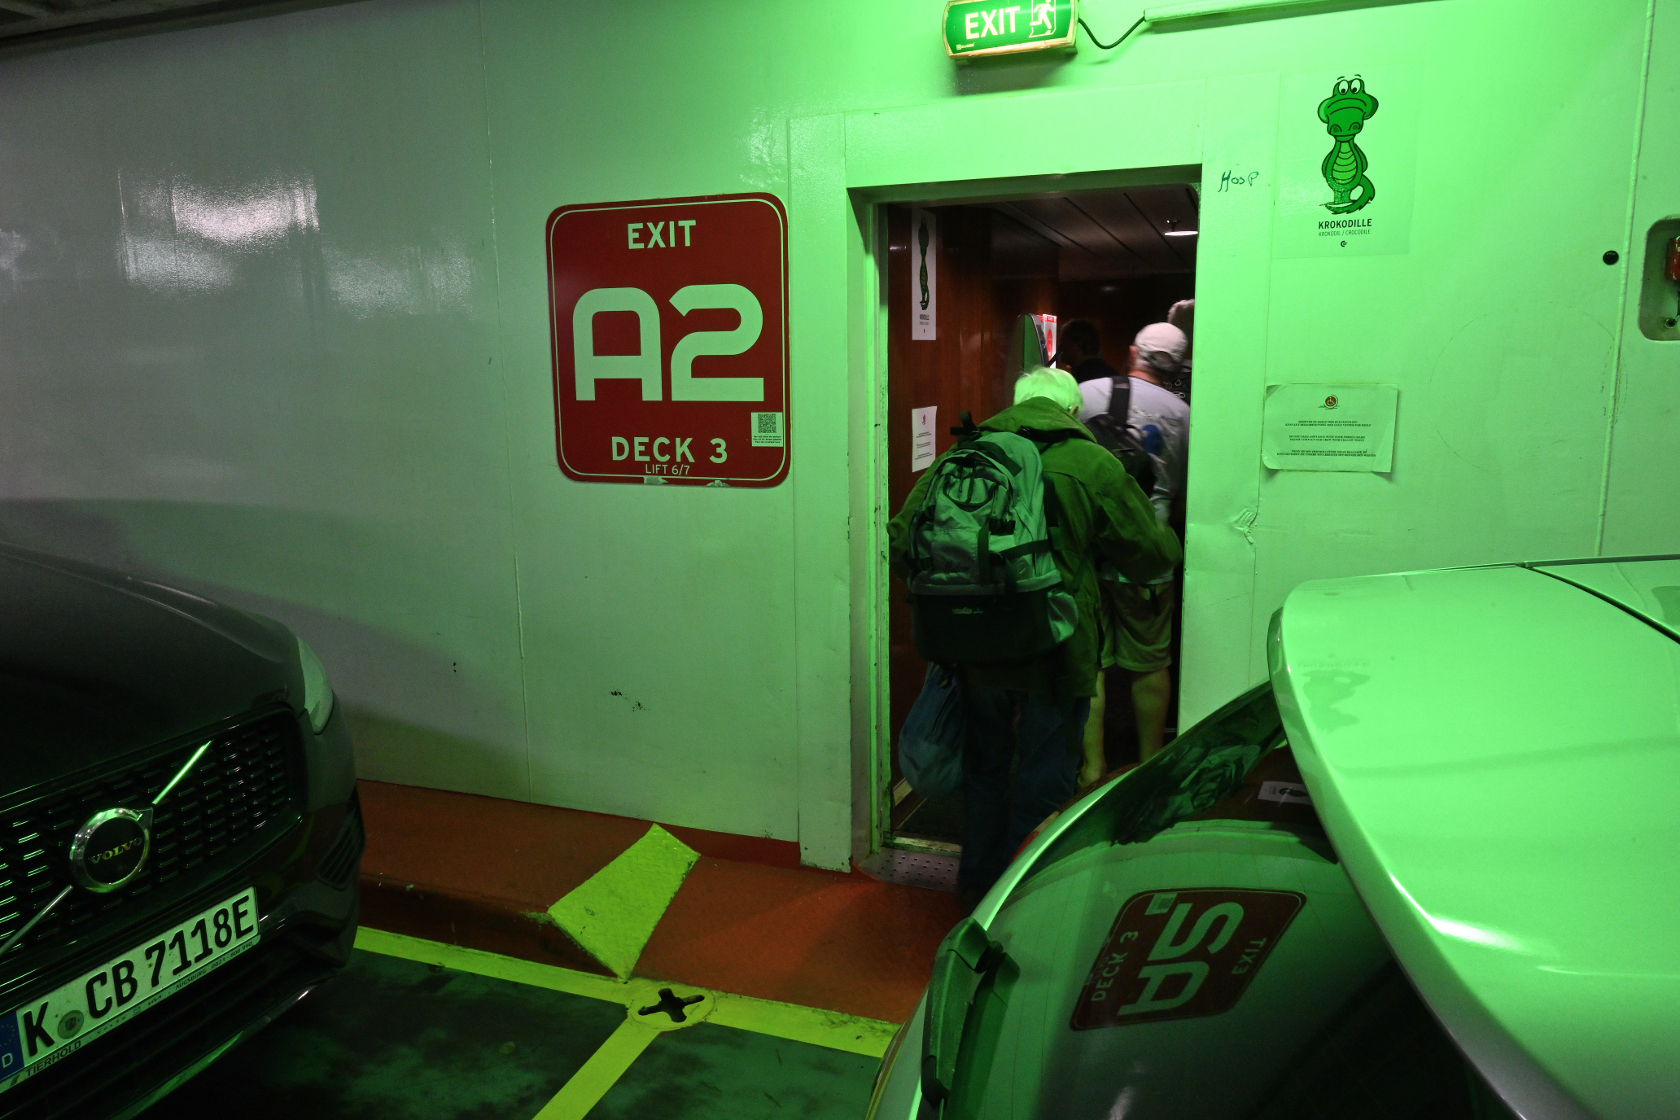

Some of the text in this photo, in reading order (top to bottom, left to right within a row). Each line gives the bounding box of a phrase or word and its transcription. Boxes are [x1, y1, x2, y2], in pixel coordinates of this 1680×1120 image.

[965, 6, 1021, 40] EXIT
[627, 219, 697, 250] EXIT
[1318, 218, 1372, 230] KROKODILLE
[572, 283, 765, 402] A2
[611, 436, 728, 464] DECK 3
[645, 463, 690, 476] LIFT 6/7
[87, 836, 142, 864] VOLVO
[22, 895, 254, 1057] K CB 7118E
[1, 1052, 14, 1069] D
[25, 1040, 82, 1077] TIERHOLD
